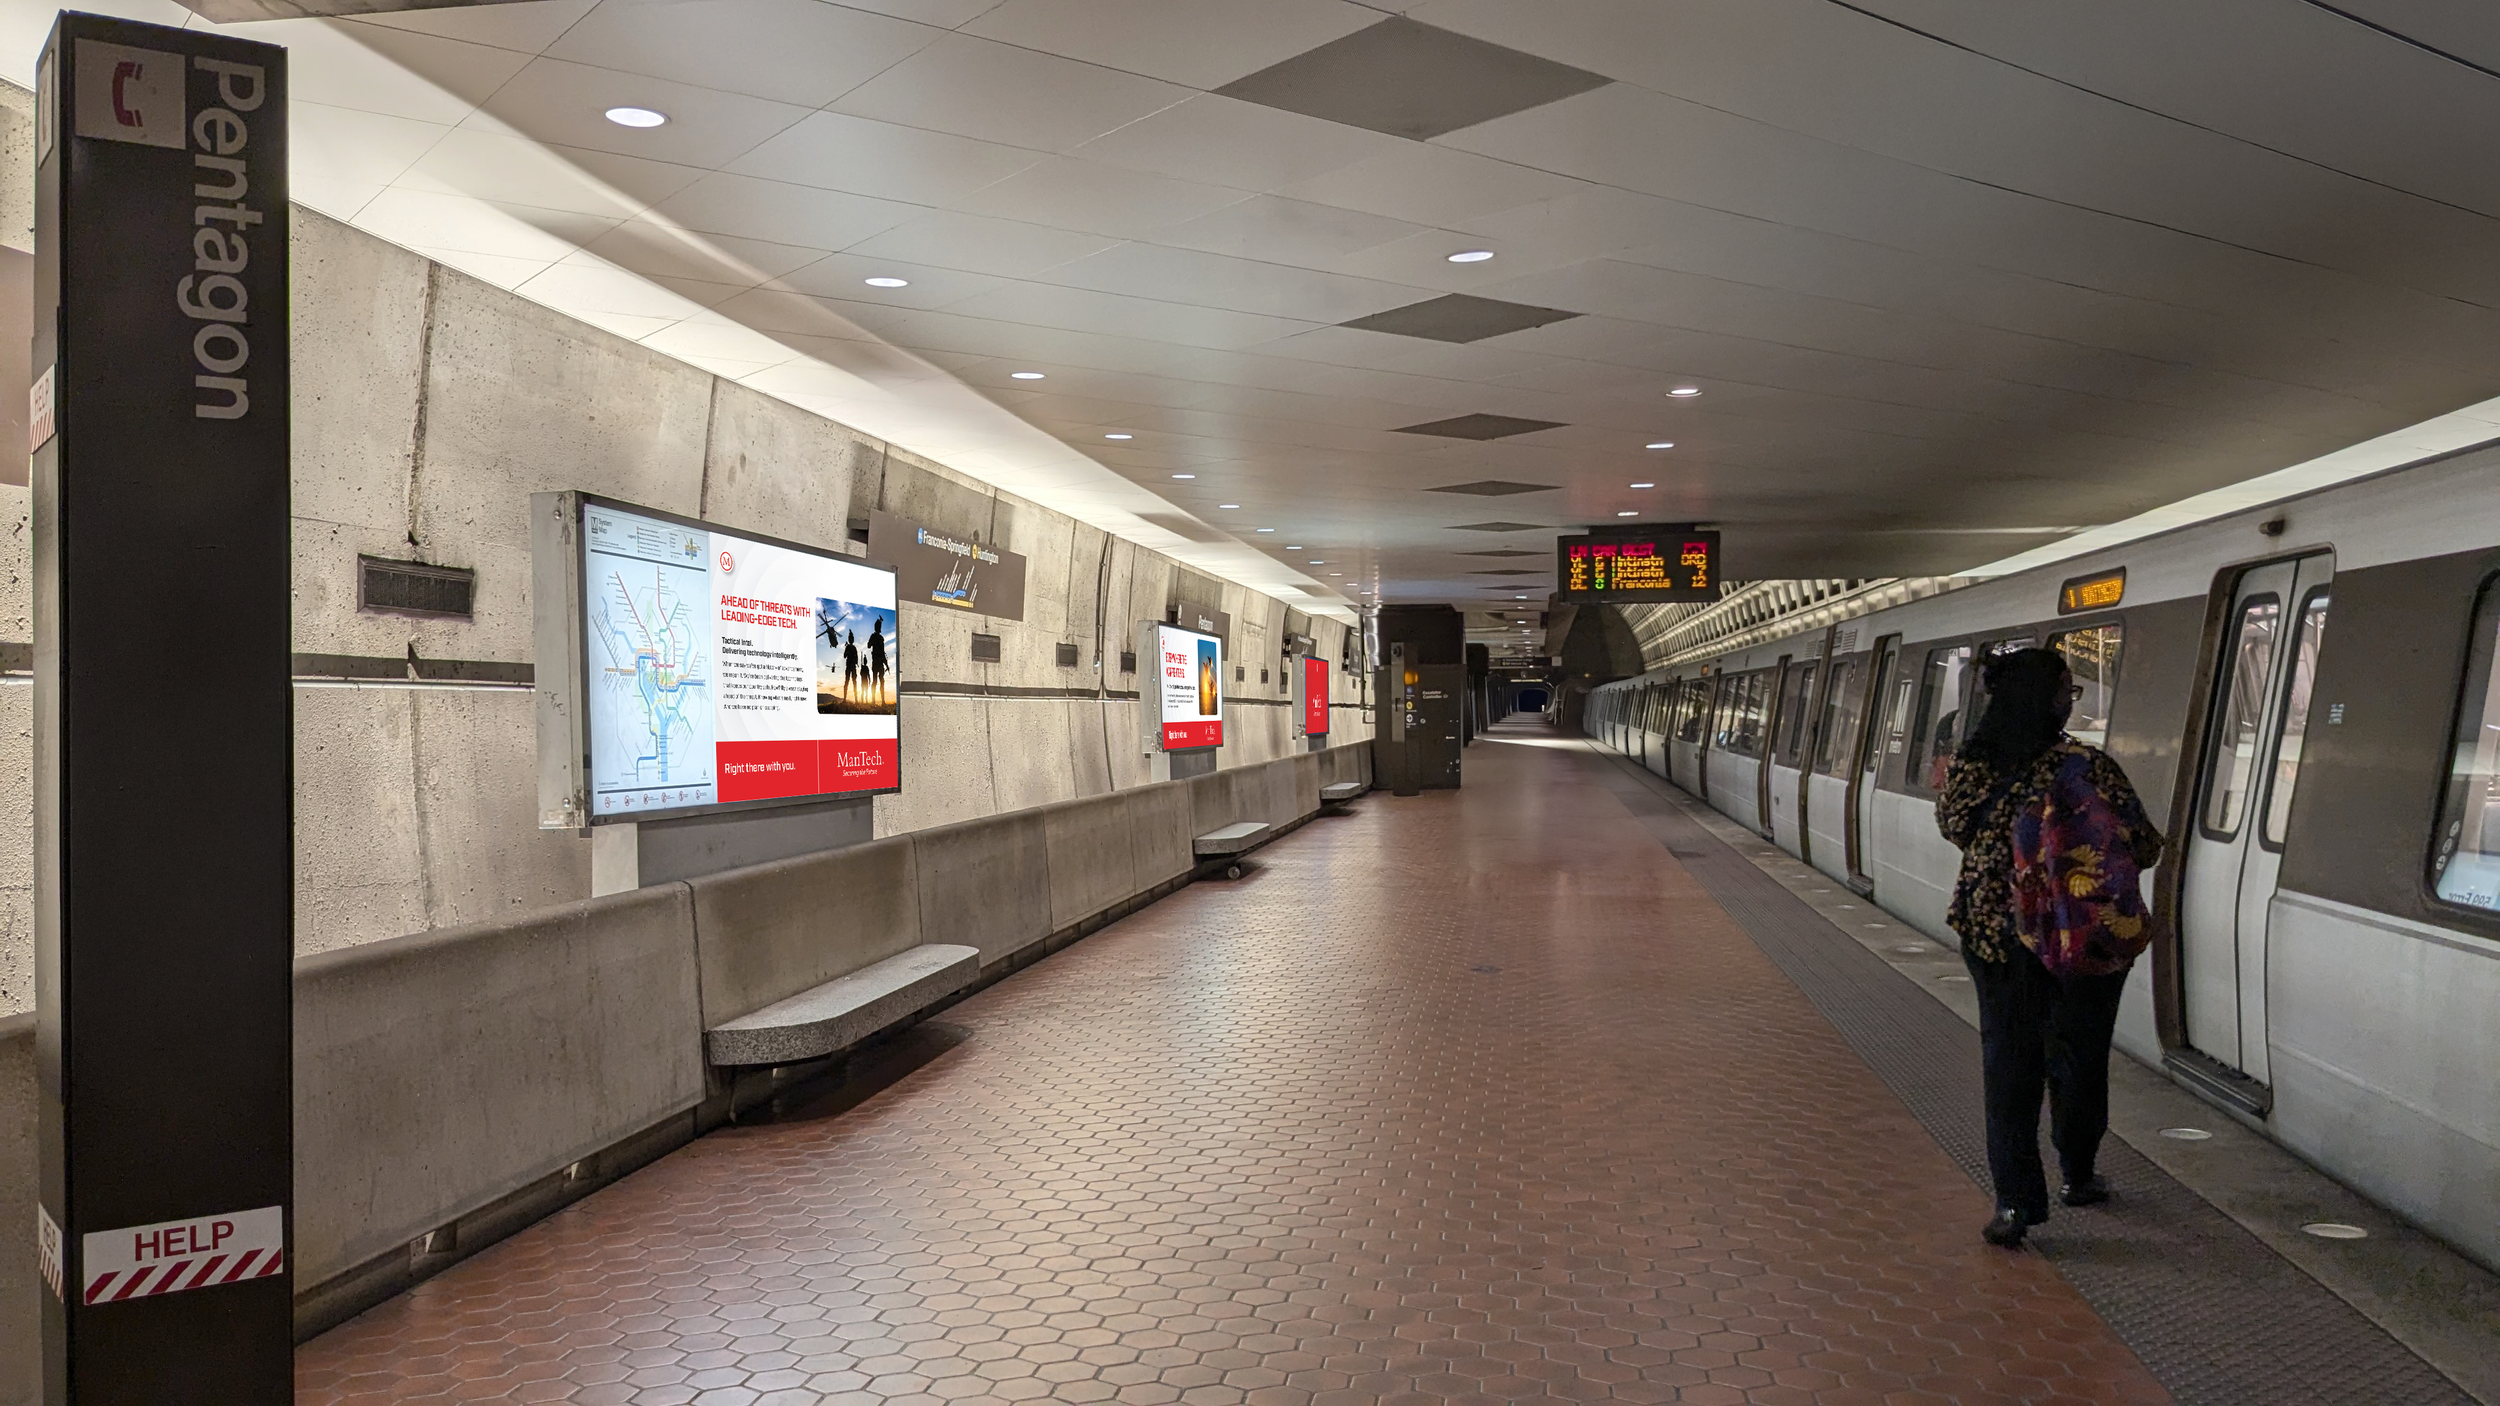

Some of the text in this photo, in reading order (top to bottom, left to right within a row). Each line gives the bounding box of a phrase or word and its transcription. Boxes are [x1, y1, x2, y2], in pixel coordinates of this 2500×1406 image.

[176, 55, 265, 420] Pentagon
[598, 518, 612, 527] System
[923, 530, 971, 557] Franconia-Springfield
[977, 546, 999, 566] Huntington
[721, 594, 810, 618] AHEAD OF THREATS WITH
[721, 609, 797, 629] LEADING-EDGE TECH.
[722, 636, 741, 646] Tactical
[722, 646, 746, 657] Delivering
[747, 649, 772, 659] technology
[724, 760, 796, 775] Right there with you.
[134, 1220, 235, 1262] HELP
